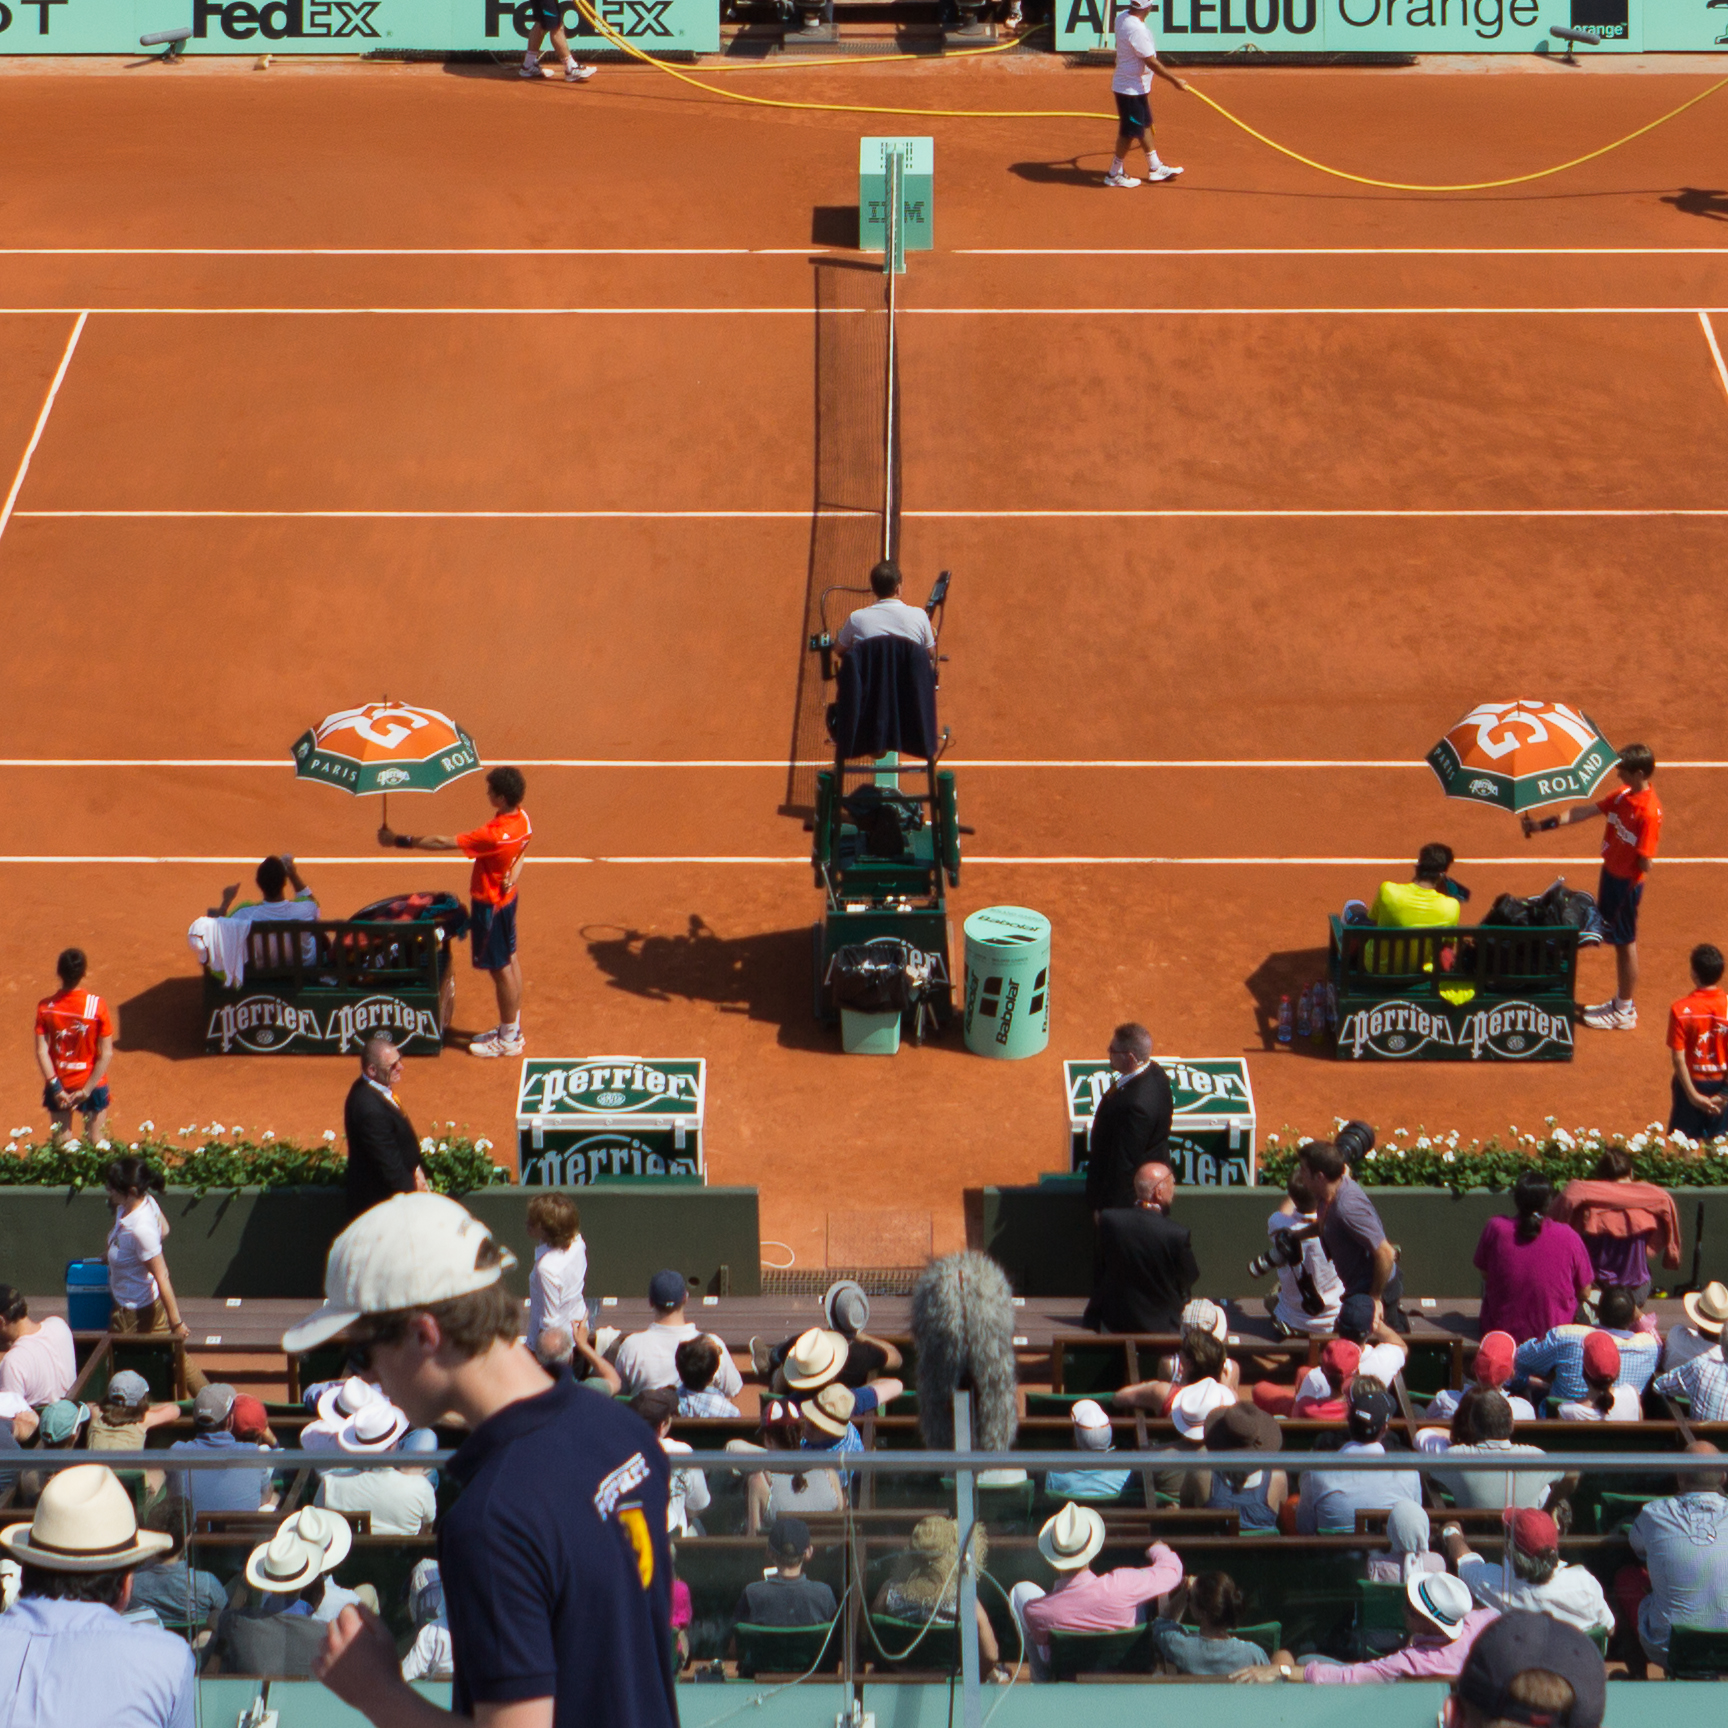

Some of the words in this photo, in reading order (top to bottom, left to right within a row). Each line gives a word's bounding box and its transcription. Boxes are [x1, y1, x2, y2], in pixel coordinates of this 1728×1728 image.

[868, 201, 924, 223] IM
[310, 759, 358, 782] PARIS
[1538, 753, 1603, 795] ROLAND
[996, 978, 1020, 1046] Babolat
